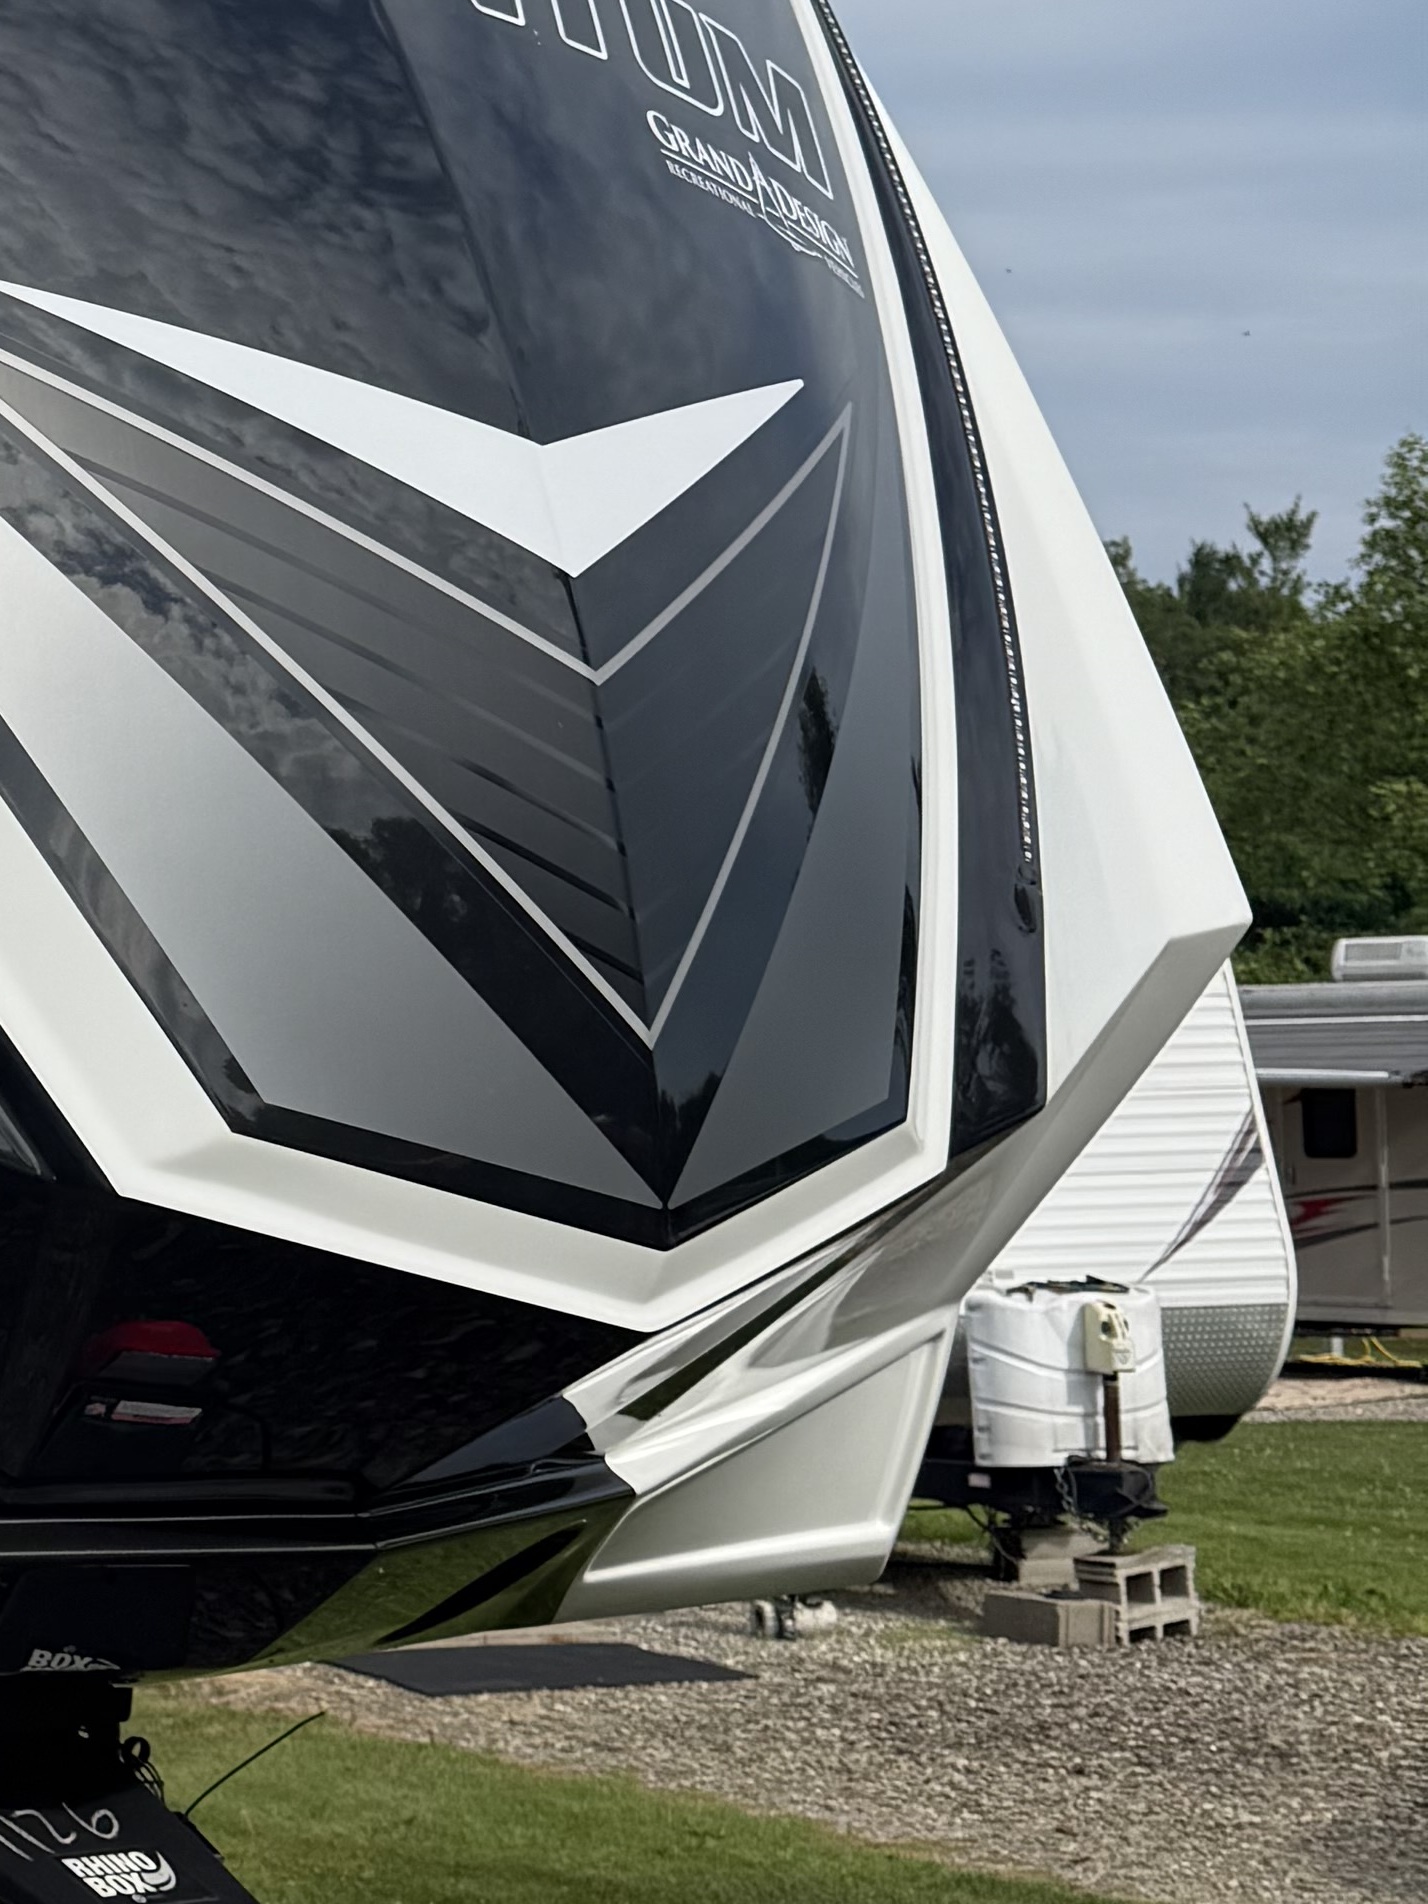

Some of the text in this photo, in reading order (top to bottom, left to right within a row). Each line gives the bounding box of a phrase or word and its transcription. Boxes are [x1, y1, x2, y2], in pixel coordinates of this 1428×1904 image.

[646, 109, 856, 269] GRAND DESIGN
[60, 1850, 158, 1878] RHINO
[82, 1872, 158, 1898] BOX
